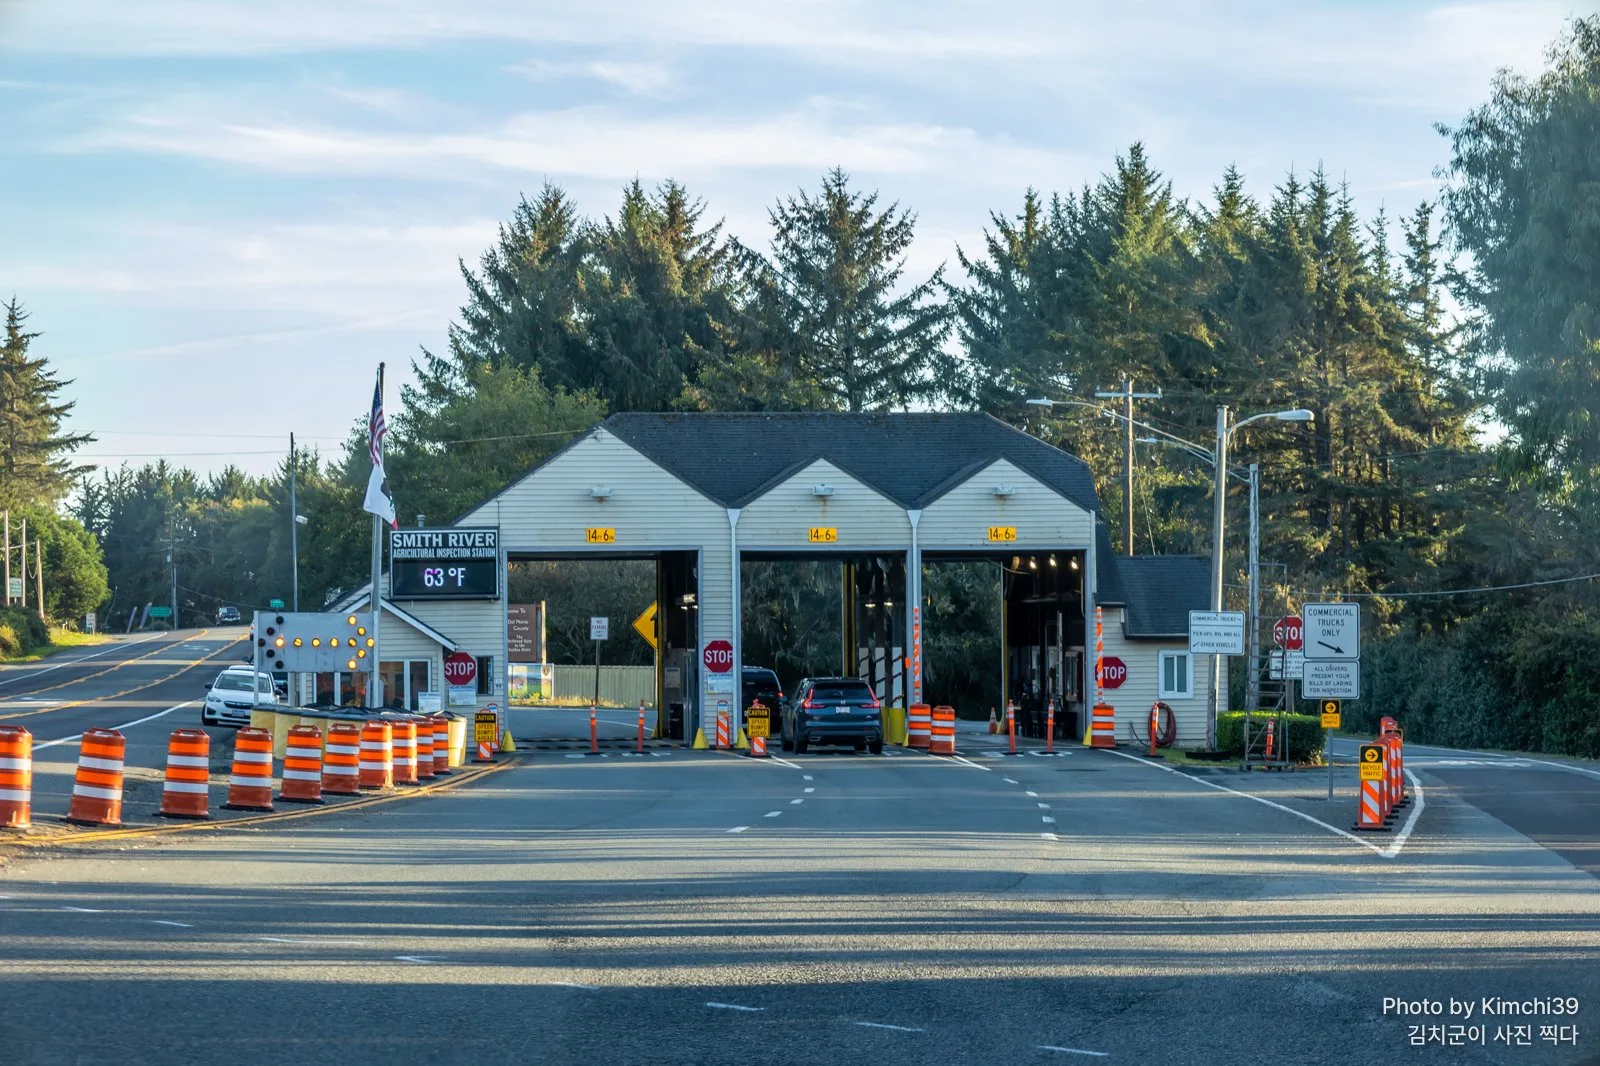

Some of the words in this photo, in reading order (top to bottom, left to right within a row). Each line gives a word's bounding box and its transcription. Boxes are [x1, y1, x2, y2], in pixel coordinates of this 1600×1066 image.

[588, 529, 597, 541] 14
[603, 529, 609, 541] 6
[810, 529, 819, 541] 14
[825, 529, 831, 541] 6
[989, 527, 999, 540] 14
[393, 534, 442, 548] SMITH
[448, 534, 496, 547] RIVER
[392, 549, 435, 558] AGRICULTURAL
[436, 548, 470, 558] INSPECTION
[471, 548, 496, 558] STATION
[1276, 626, 1303, 641] STO
[1321, 629, 1340, 637] ONLY
[705, 650, 732, 664] STOP
[445, 662, 475, 675] STOP
[1099, 666, 1125, 680] TOP
